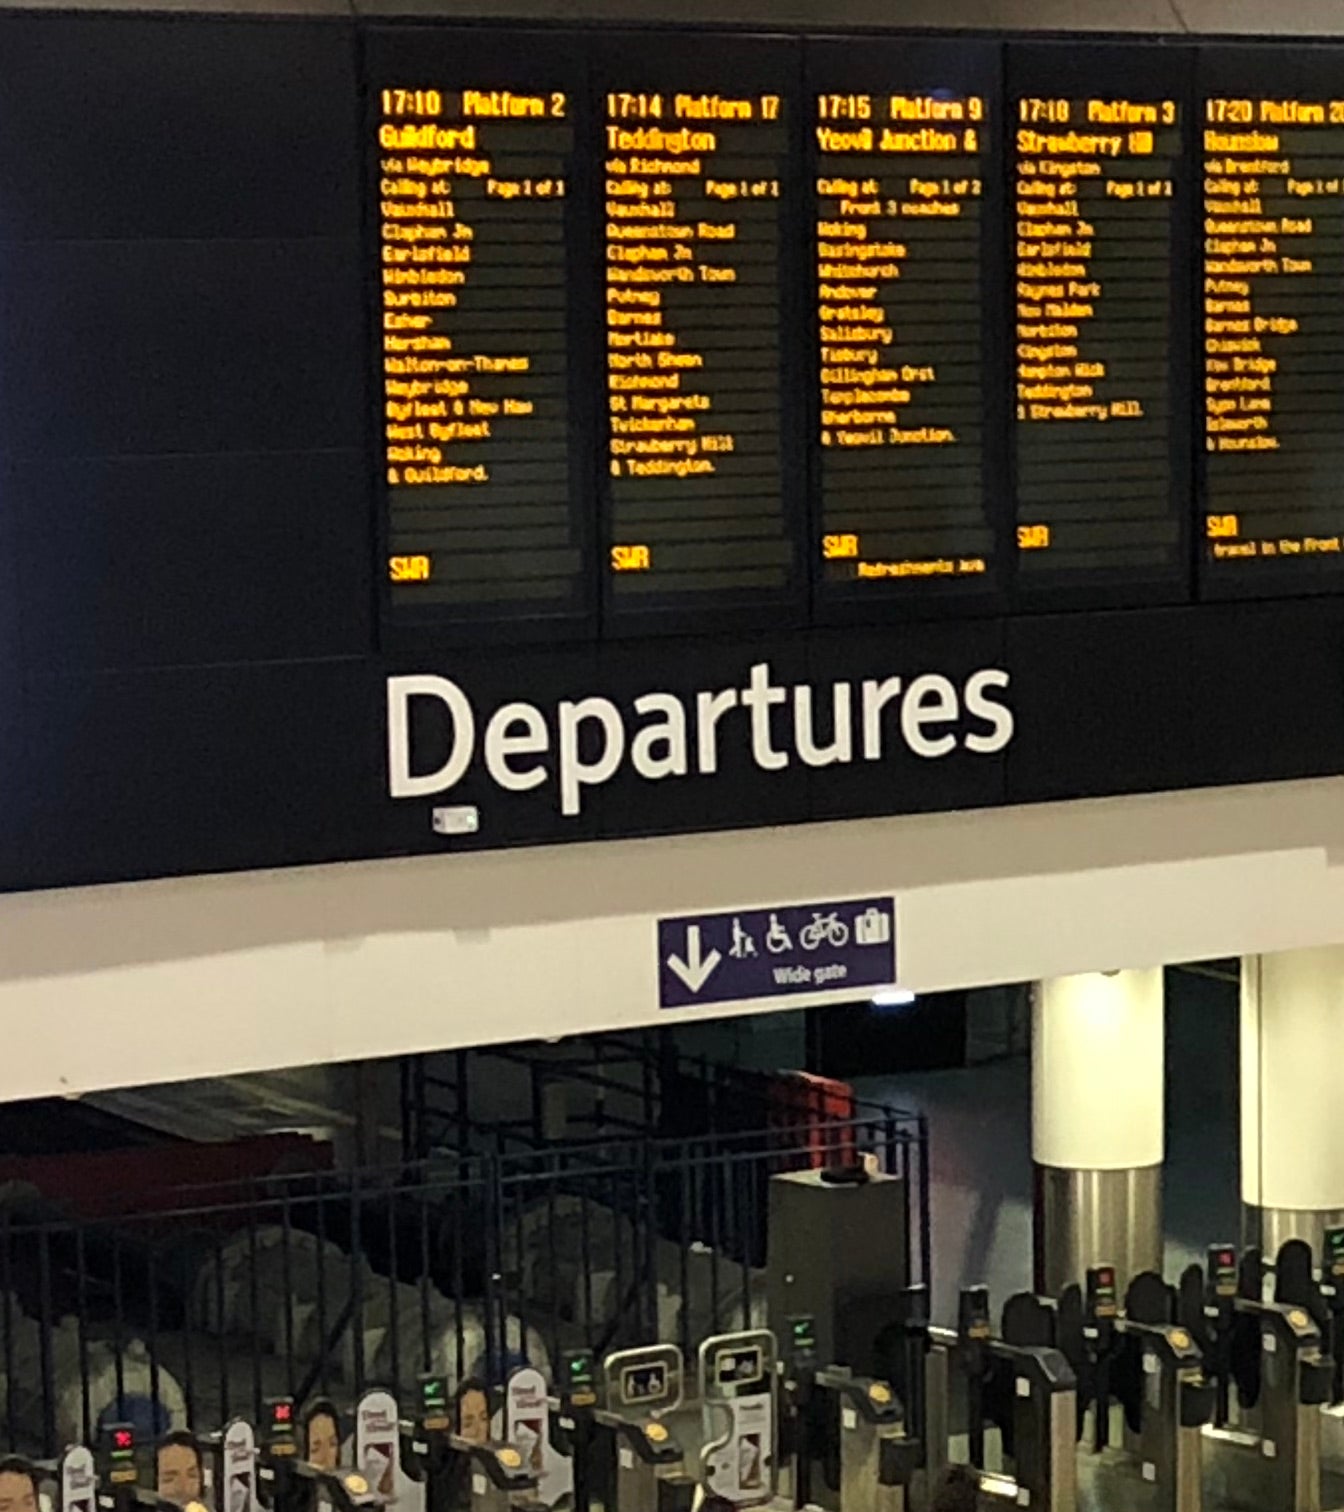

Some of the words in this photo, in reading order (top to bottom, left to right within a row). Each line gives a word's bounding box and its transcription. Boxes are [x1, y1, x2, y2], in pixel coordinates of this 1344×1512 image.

[383, 90, 442, 115] 17:10
[463, 91, 545, 116] Platform
[551, 93, 565, 116] 2
[608, 94, 662, 118] 17:14
[675, 94, 752, 119] Platform
[761, 96, 779, 119] 17
[819, 95, 871, 119] 17:15
[890, 96, 964, 120] Platform
[968, 97, 982, 120] 9
[1088, 100, 1157, 123] Platform
[1162, 101, 1175, 124] 3
[1207, 100, 1253, 122] 17:20
[1260, 101, 1325, 123] Platform
[379, 124, 475, 149] Guildford
[607, 126, 715, 154] Teddington
[879, 128, 957, 151] Junction
[964, 129, 977, 151] &
[1017, 130, 1122, 156] Strawberry
[612, 546, 649, 570] SWR
[823, 535, 858, 558] SWR
[390, 556, 429, 580] SWR
[386, 662, 1015, 815] Departures
[773, 965, 811, 983] Wide
[813, 964, 847, 984] gate
